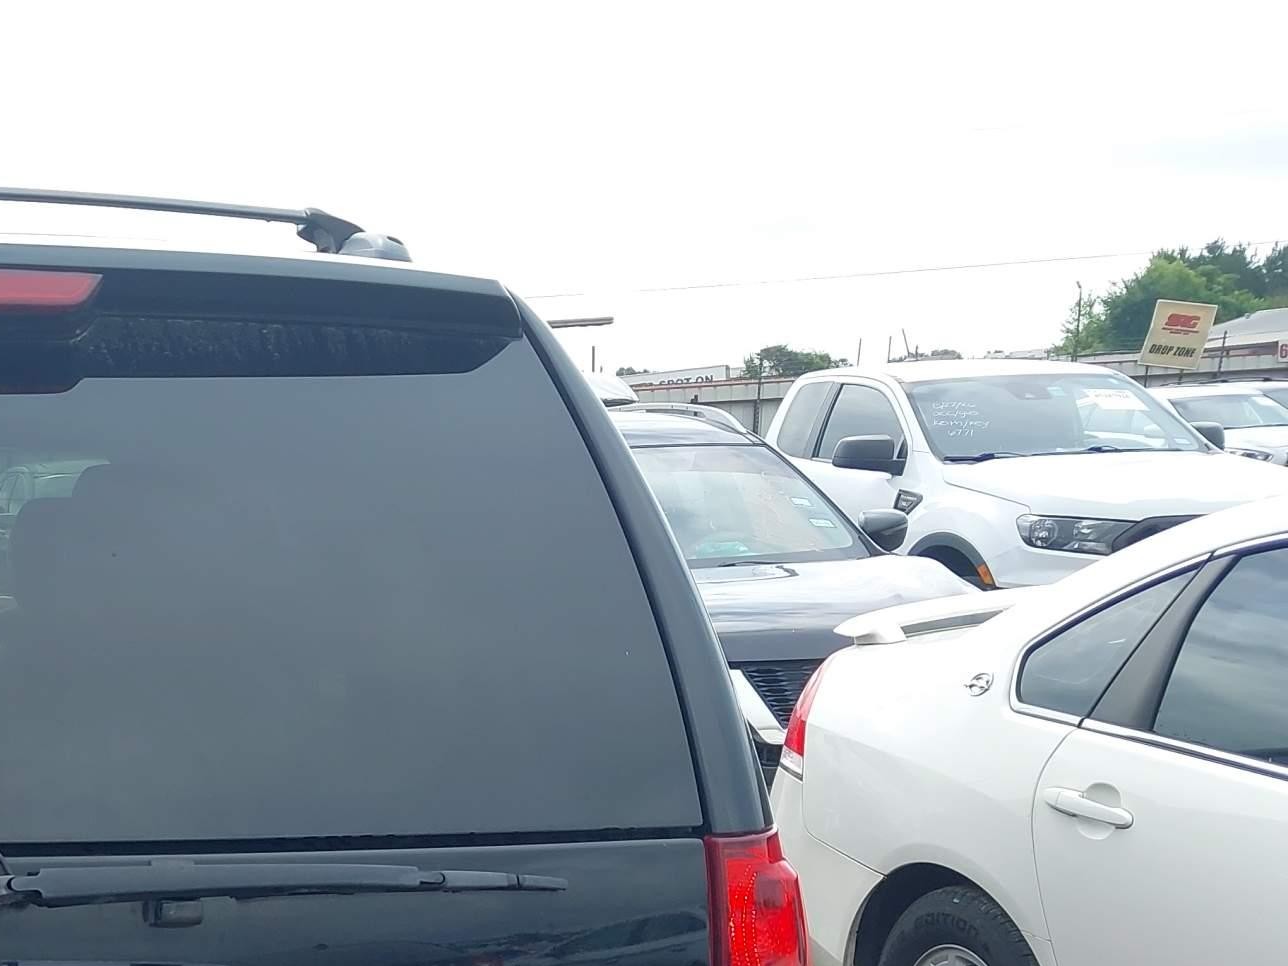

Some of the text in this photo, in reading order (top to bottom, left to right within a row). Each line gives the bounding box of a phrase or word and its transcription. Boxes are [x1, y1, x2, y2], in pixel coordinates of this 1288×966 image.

[1149, 343, 1197, 358] DROP ZONE
[695, 375, 713, 384] ON
